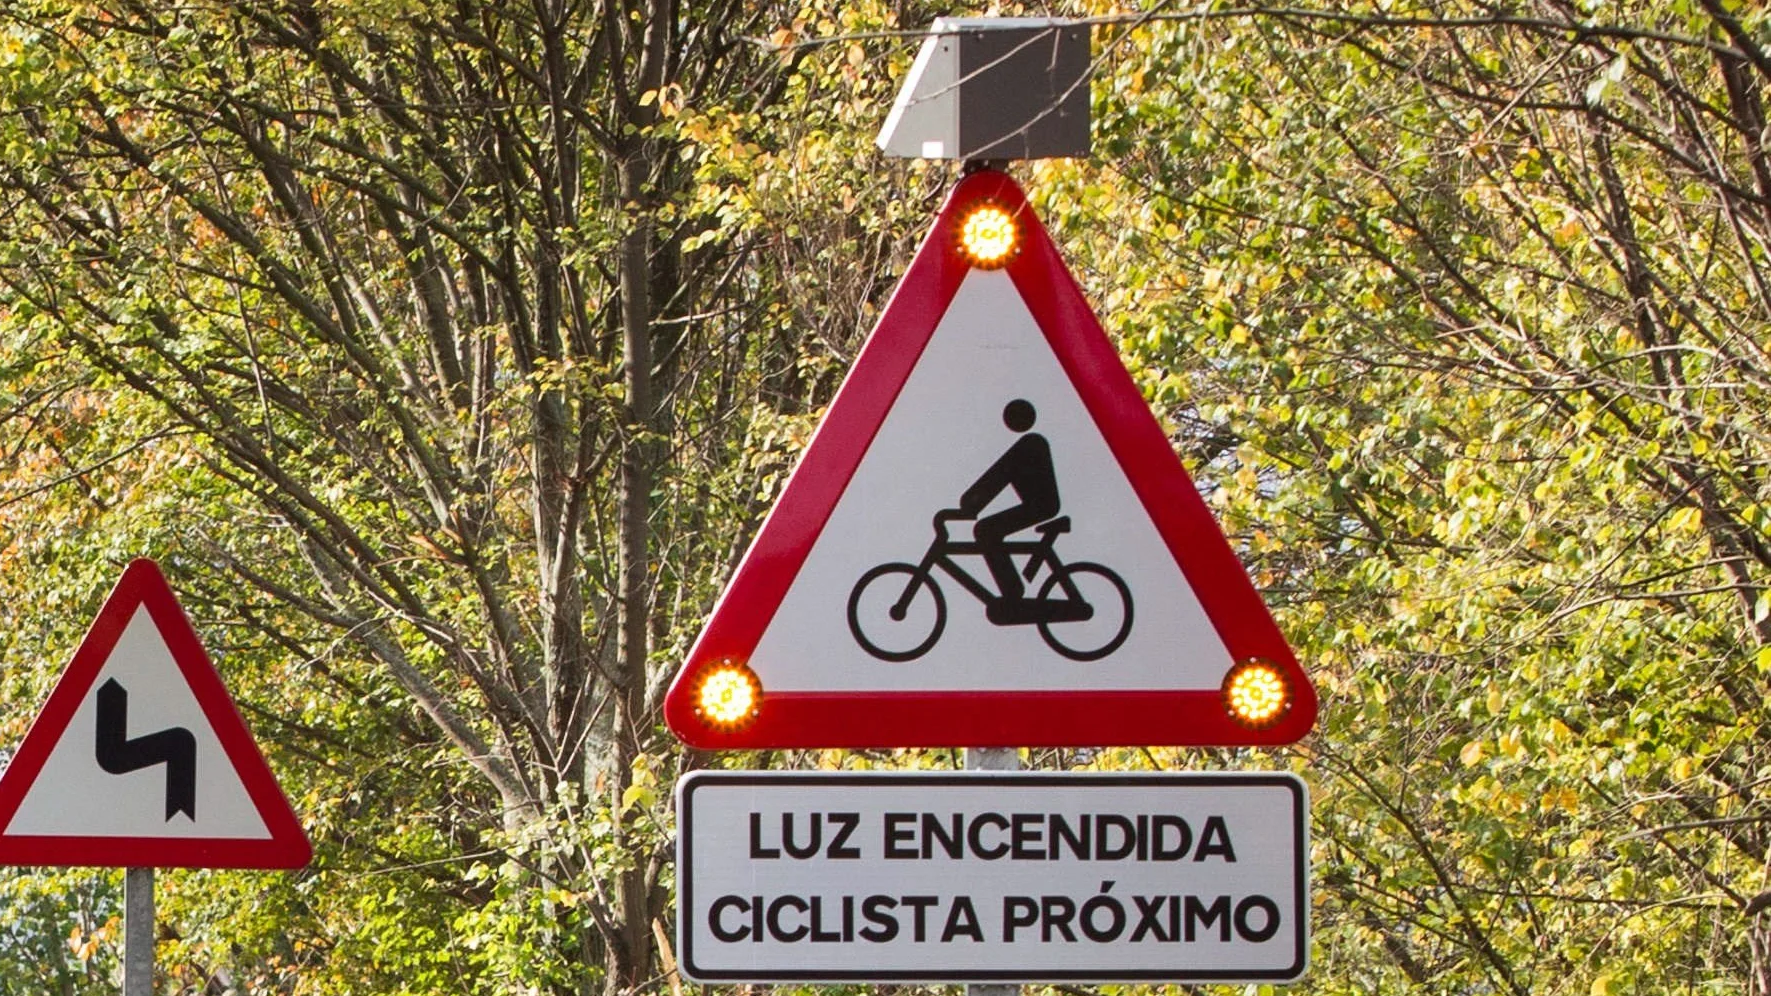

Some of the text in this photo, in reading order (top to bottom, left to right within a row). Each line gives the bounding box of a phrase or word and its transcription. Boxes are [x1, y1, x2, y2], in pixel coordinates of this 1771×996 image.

[749, 812, 1238, 863] LUZ ENCENDIDA
[707, 881, 1282, 943] CICLISTA PRÓXIMO
